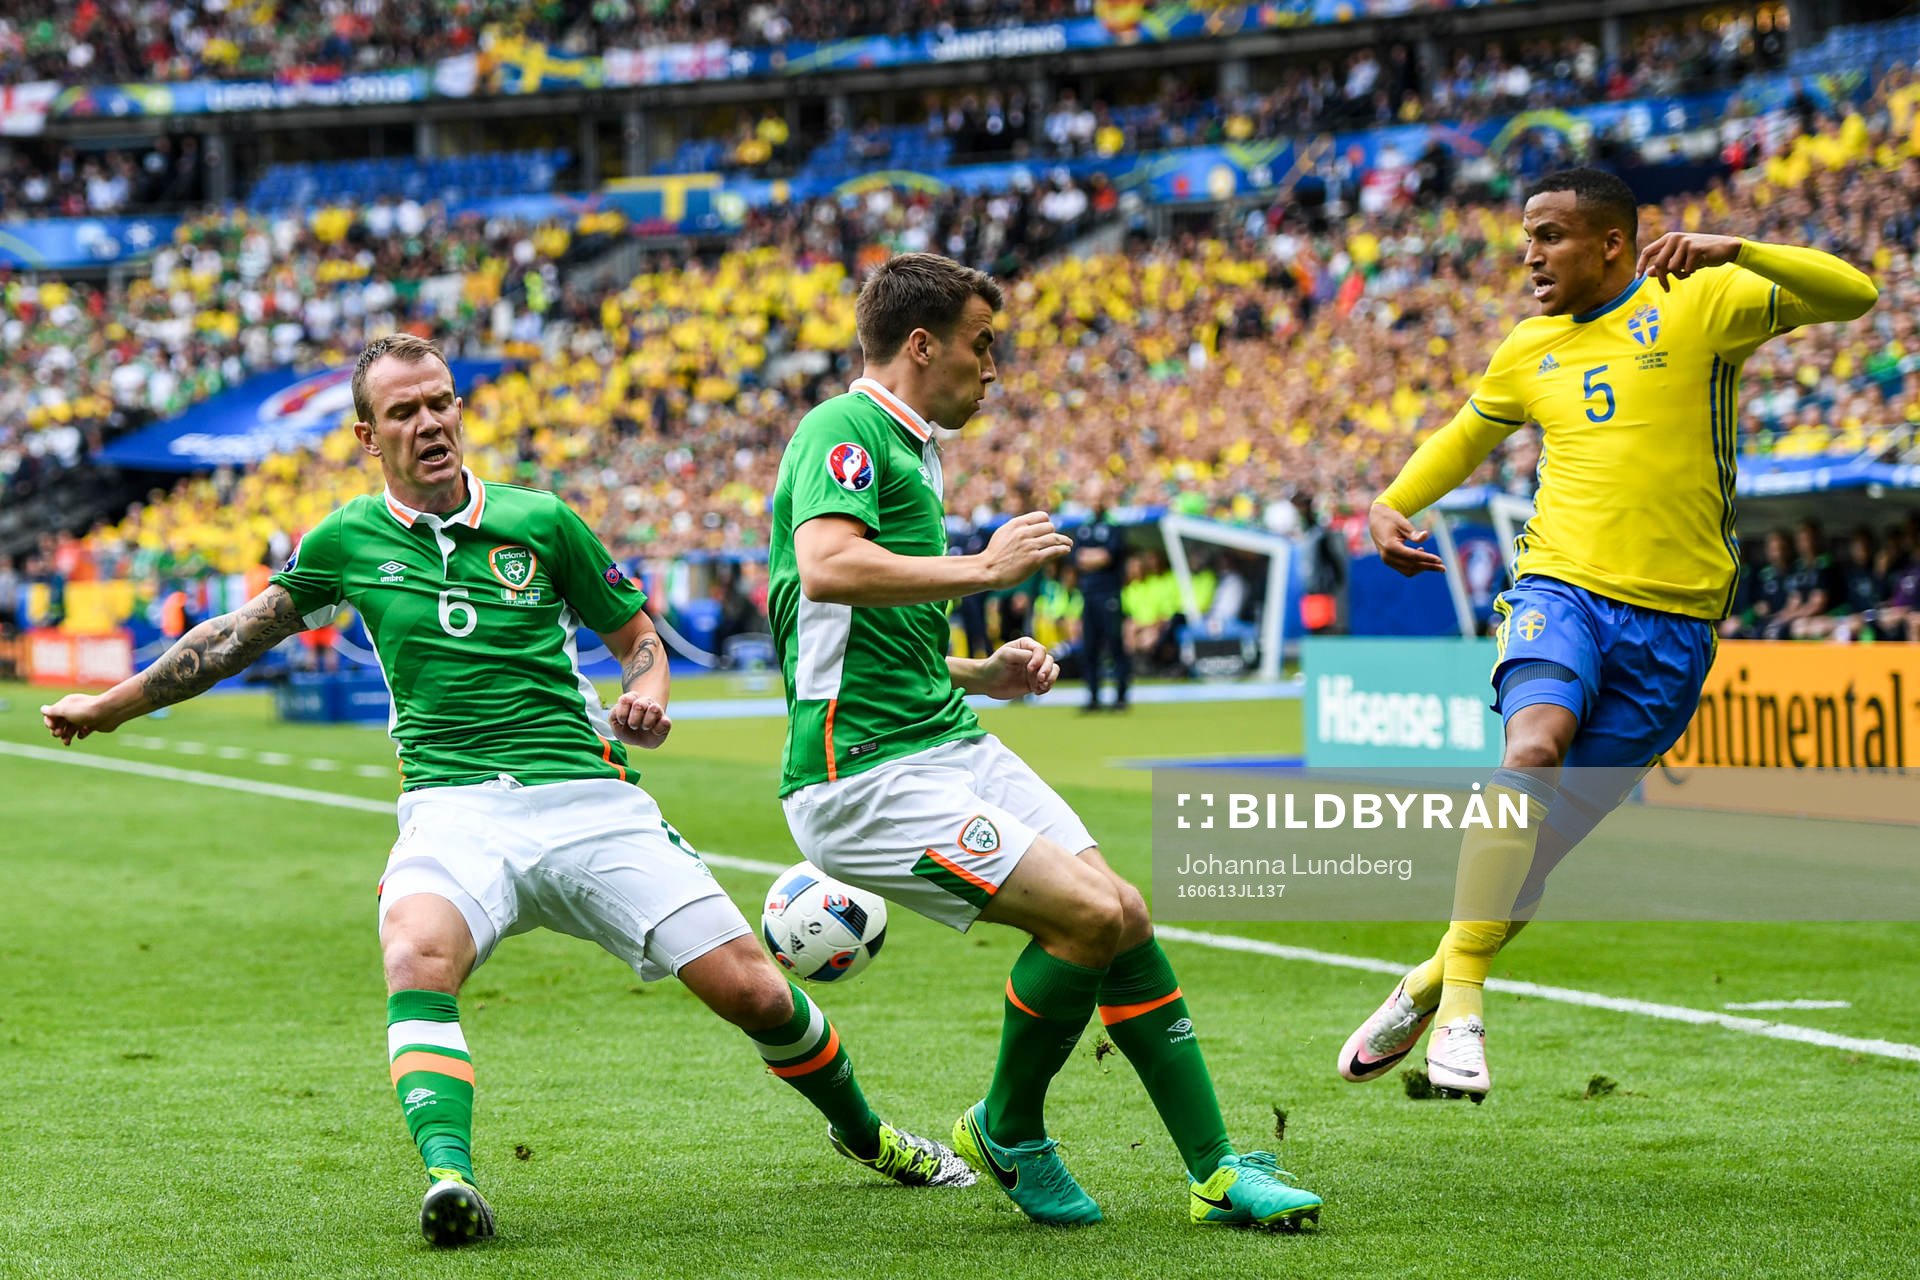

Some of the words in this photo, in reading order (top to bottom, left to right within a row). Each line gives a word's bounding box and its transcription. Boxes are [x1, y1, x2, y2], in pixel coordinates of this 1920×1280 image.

[1583, 364, 1615, 423] 5
[380, 574, 404, 582] umbro
[498, 551, 526, 560] Ireland
[438, 587, 477, 637] 6
[1316, 674, 1445, 750] Hisense
[1660, 666, 1905, 785] ntinental
[406, 1100, 437, 1115] umbro
